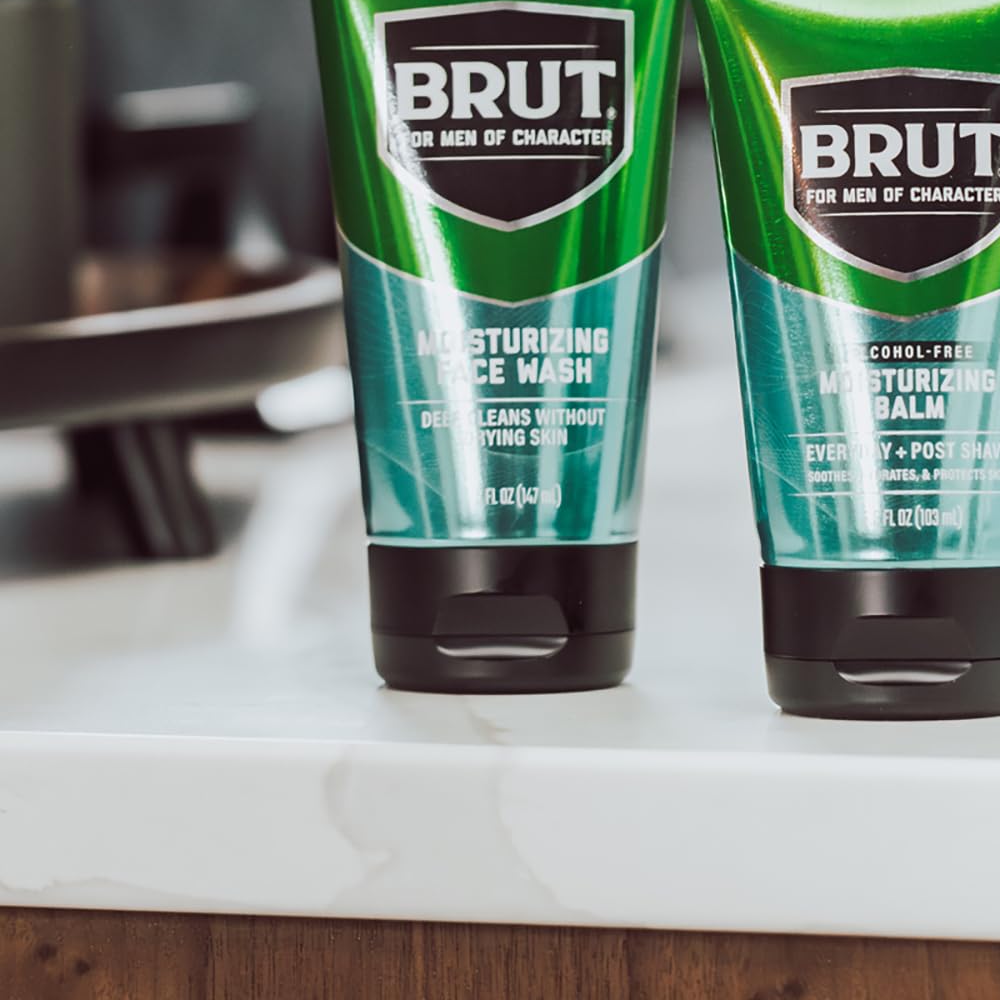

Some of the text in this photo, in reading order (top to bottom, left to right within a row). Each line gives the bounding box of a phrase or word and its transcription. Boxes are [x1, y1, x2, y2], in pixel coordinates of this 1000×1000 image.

[393, 60, 616, 121] BRUT
[398, 128, 613, 149] OR MEN OF CHARACTER
[806, 188, 837, 204] FOR
[843, 187, 877, 203] MEN
[883, 187, 904, 202] OF
[417, 327, 609, 356] MSTURIZING
[517, 357, 592, 384] WASH
[820, 368, 996, 394] MSTURIZING
[874, 395, 945, 420] BALM
[421, 408, 606, 429] DEE LEANS WITHOUT
[470, 428, 568, 447] RYING SKIN
[806, 442, 892, 462] EVERY
[911, 441, 955, 460] POST
[485, 487, 498, 505] FL
[500, 487, 515, 505] OZ
[883, 508, 896, 527] FL
[898, 508, 913, 527] OZ
